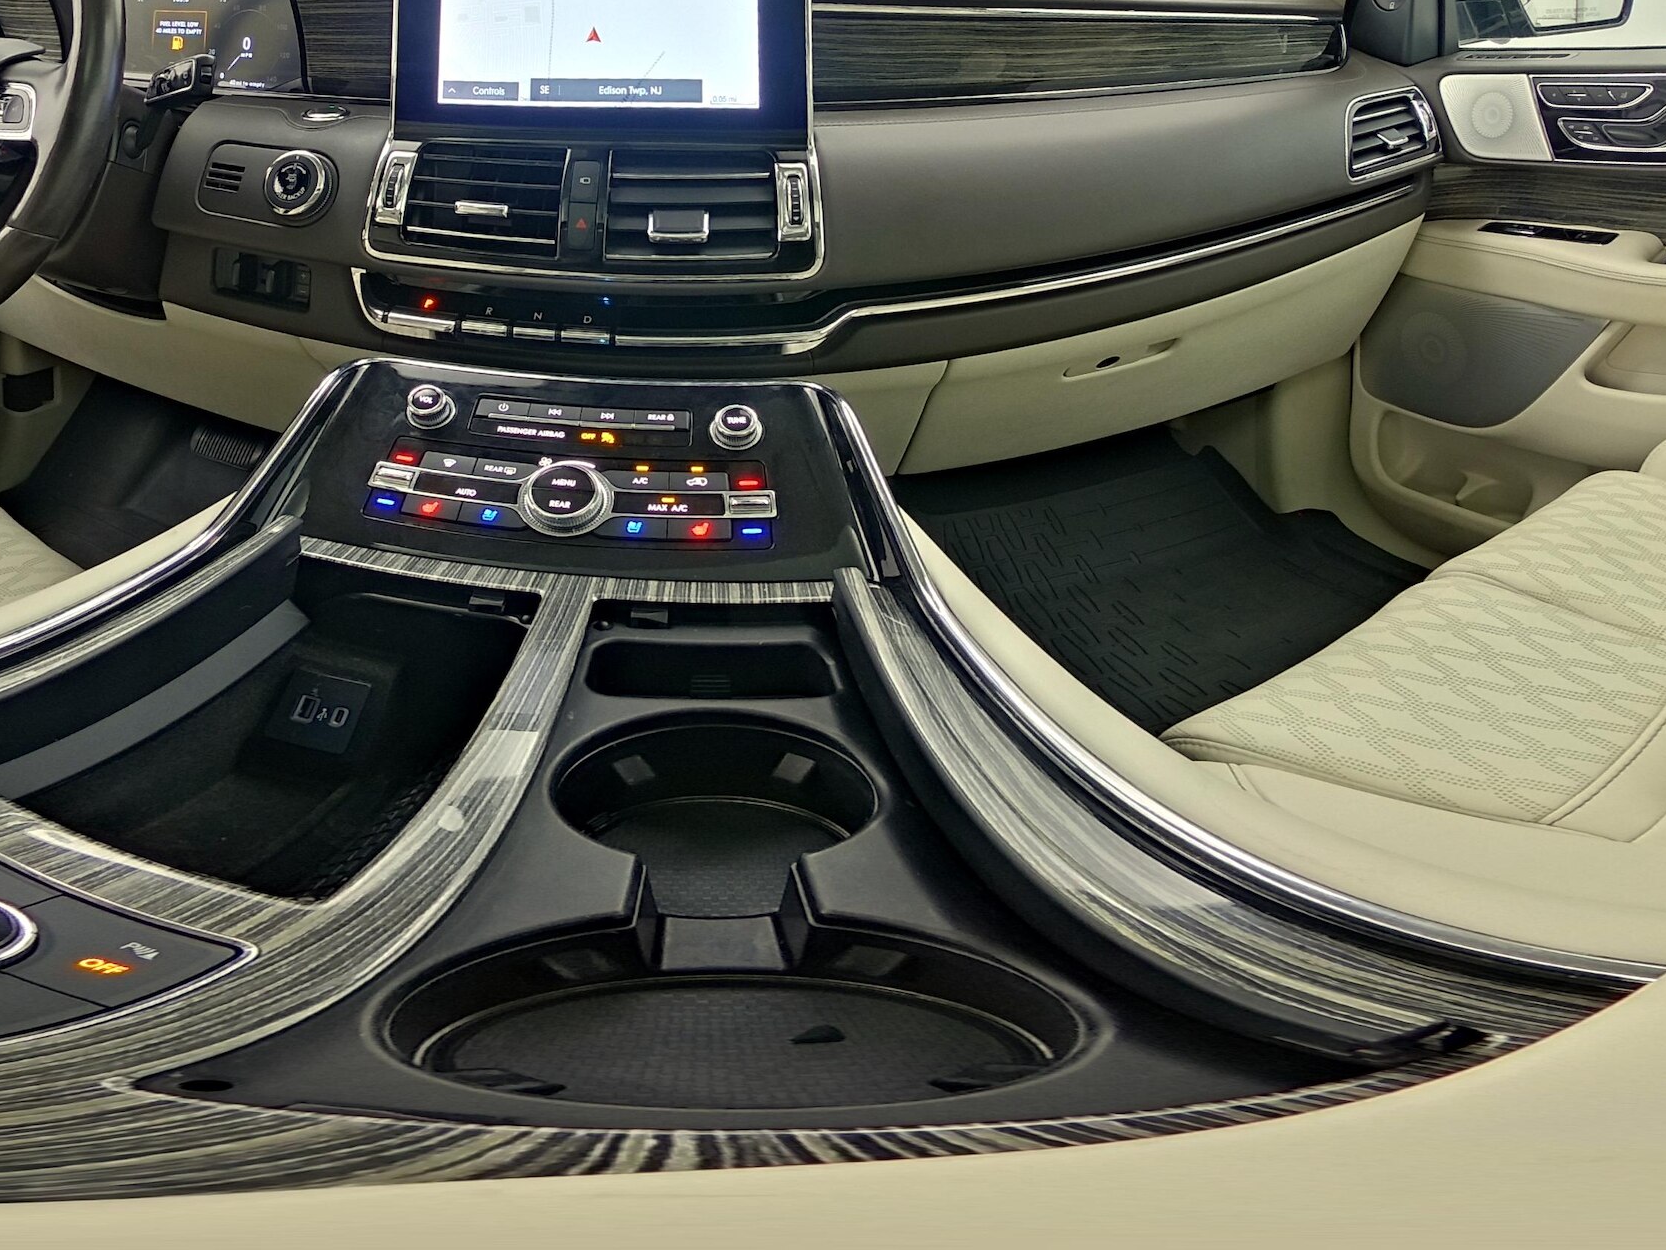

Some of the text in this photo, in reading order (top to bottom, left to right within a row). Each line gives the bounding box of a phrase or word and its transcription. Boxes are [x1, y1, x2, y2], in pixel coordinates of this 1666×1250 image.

[242, 36, 251, 51] 0
[472, 85, 506, 96] Controls
[539, 85, 550, 95] SE
[598, 85, 662, 97] Edison Twp, NJ
[287, 186, 306, 201] BACKUP
[423, 298, 592, 324] P R N D
[419, 395, 433, 404] VOL
[647, 413, 667, 422] REAR
[726, 416, 747, 425] TUNE
[497, 425, 596, 440] PASSENGER AIRBAG OFF
[484, 464, 504, 473] REAR
[551, 478, 577, 487] MENU
[632, 477, 649, 485] A/C
[455, 487, 477, 497] AUTO
[548, 499, 571, 509] REAR
[647, 503, 688, 512] MAX A/C
[77, 958, 130, 974] OFF
